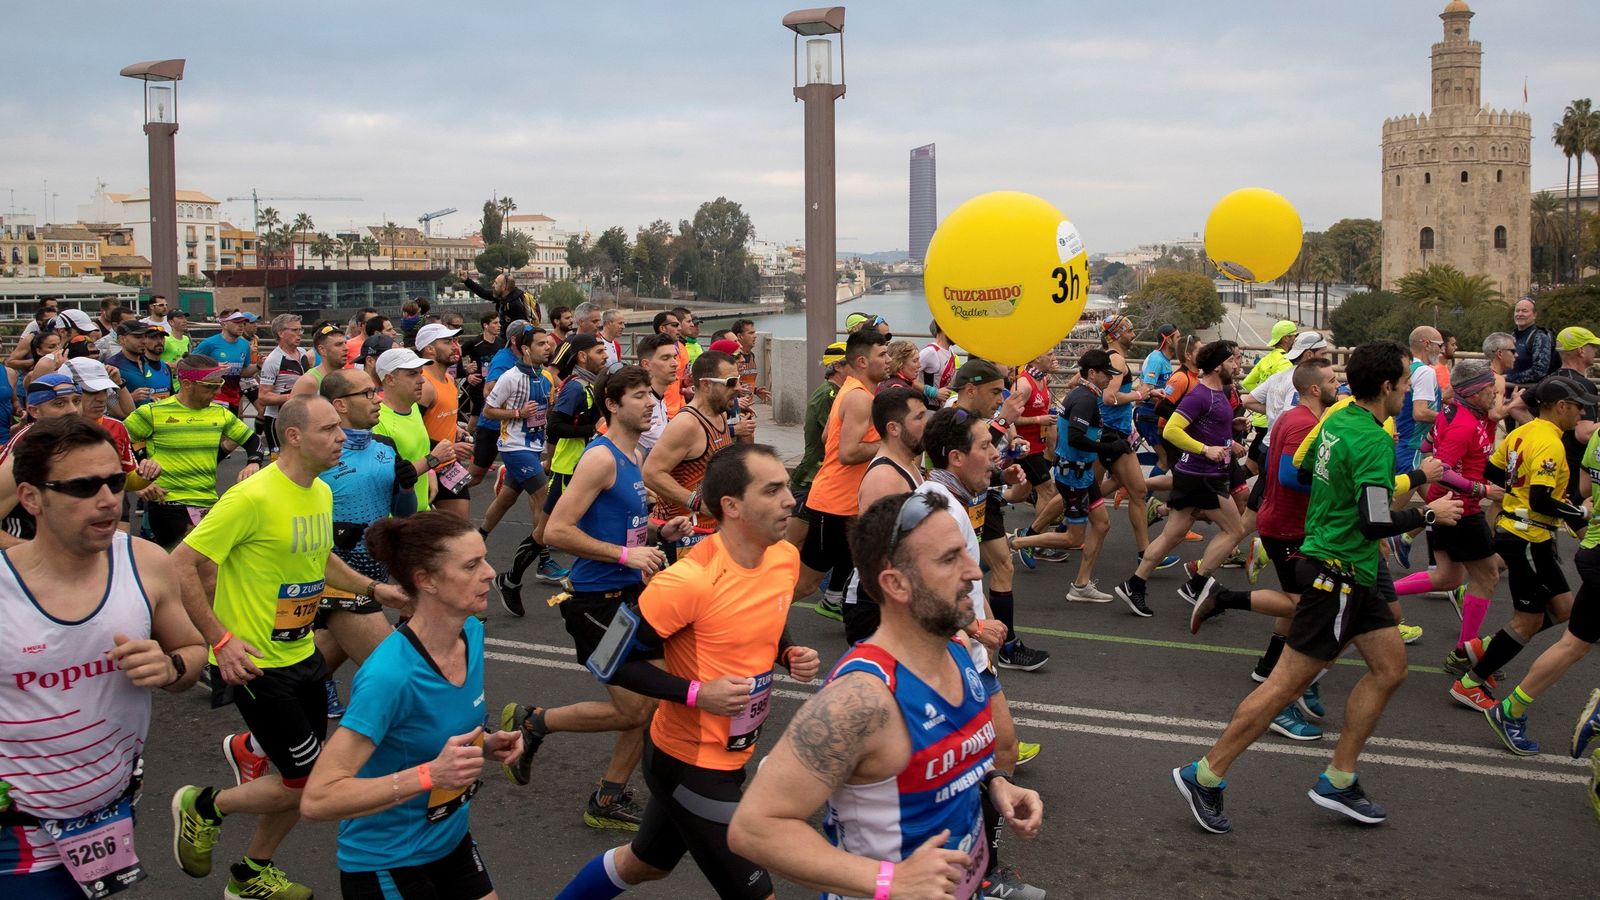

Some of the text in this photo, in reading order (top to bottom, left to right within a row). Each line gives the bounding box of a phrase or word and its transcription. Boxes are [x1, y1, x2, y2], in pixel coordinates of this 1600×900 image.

[943, 285, 1022, 302] Cruzcampo
[1051, 265, 1079, 304] 3h
[951, 304, 988, 320] Radler
[291, 512, 331, 554] RUN
[302, 582, 325, 594] ZURIC
[925, 748, 959, 780] C.A.
[961, 720, 996, 761] PUEBL
[935, 786, 950, 803] LA
[950, 765, 984, 796] PUEBLA
[992, 814, 1005, 848] kale
[66, 836, 116, 867] 5266
